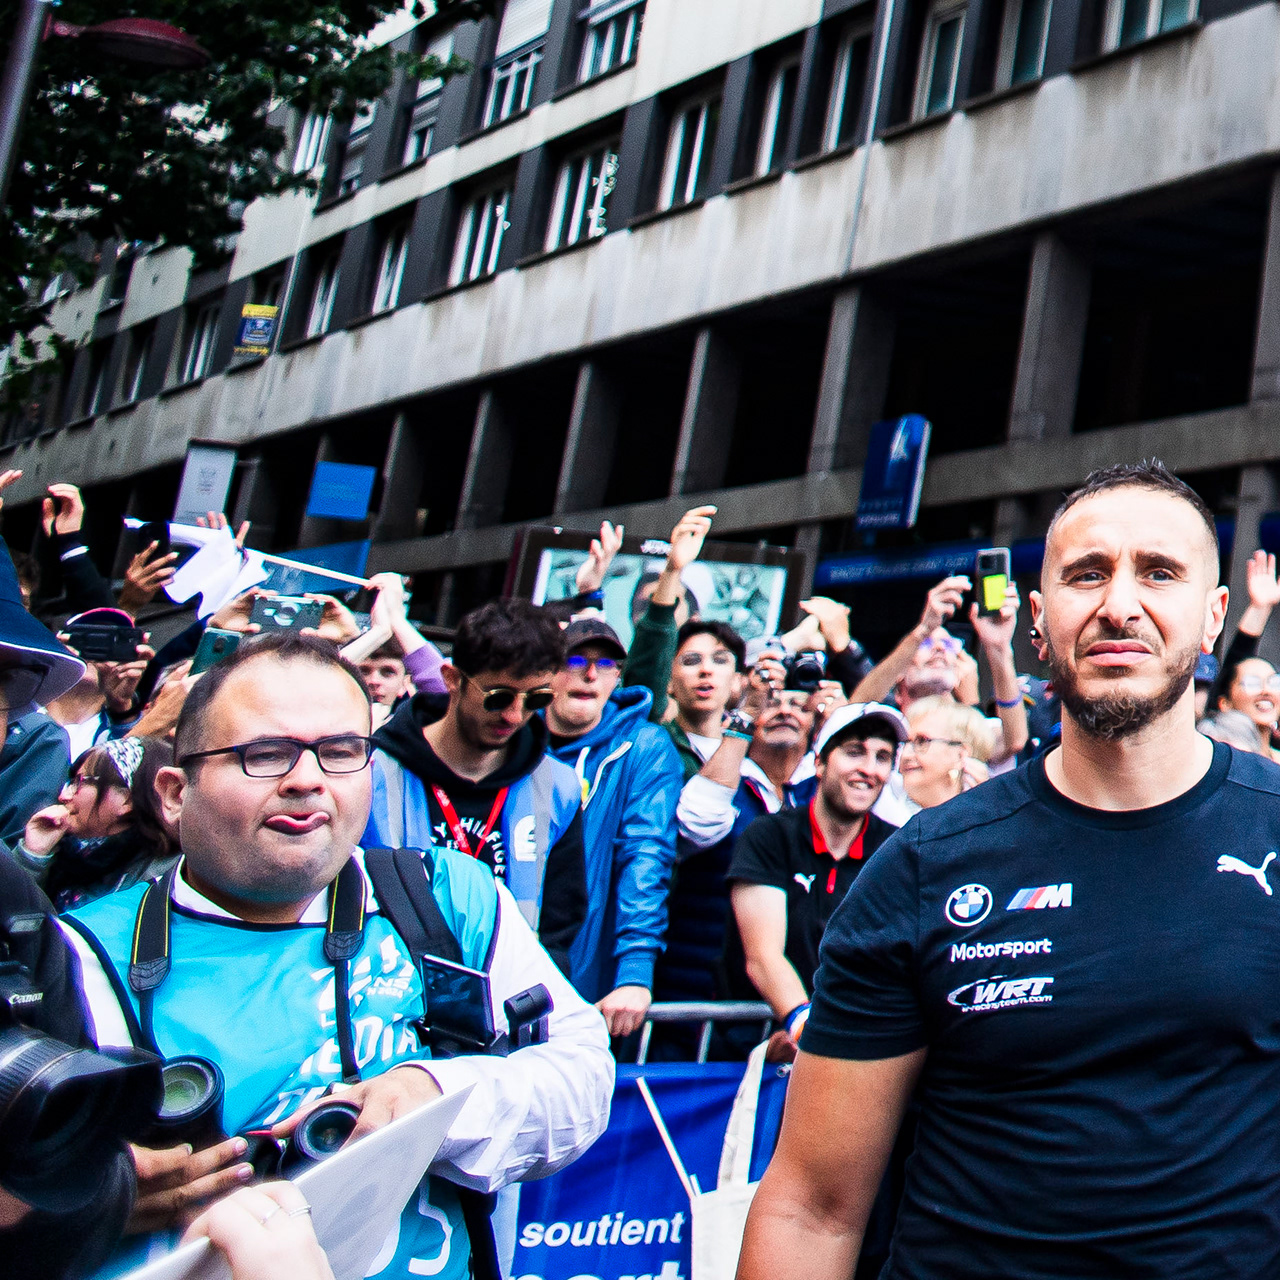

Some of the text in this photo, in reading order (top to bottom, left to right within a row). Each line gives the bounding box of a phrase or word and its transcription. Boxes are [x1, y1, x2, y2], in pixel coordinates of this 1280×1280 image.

[950, 937, 1053, 963] Motorsport
[9, 991, 44, 1005] Canon
[973, 977, 1055, 1004] WRT
[518, 1210, 686, 1249] soutient
